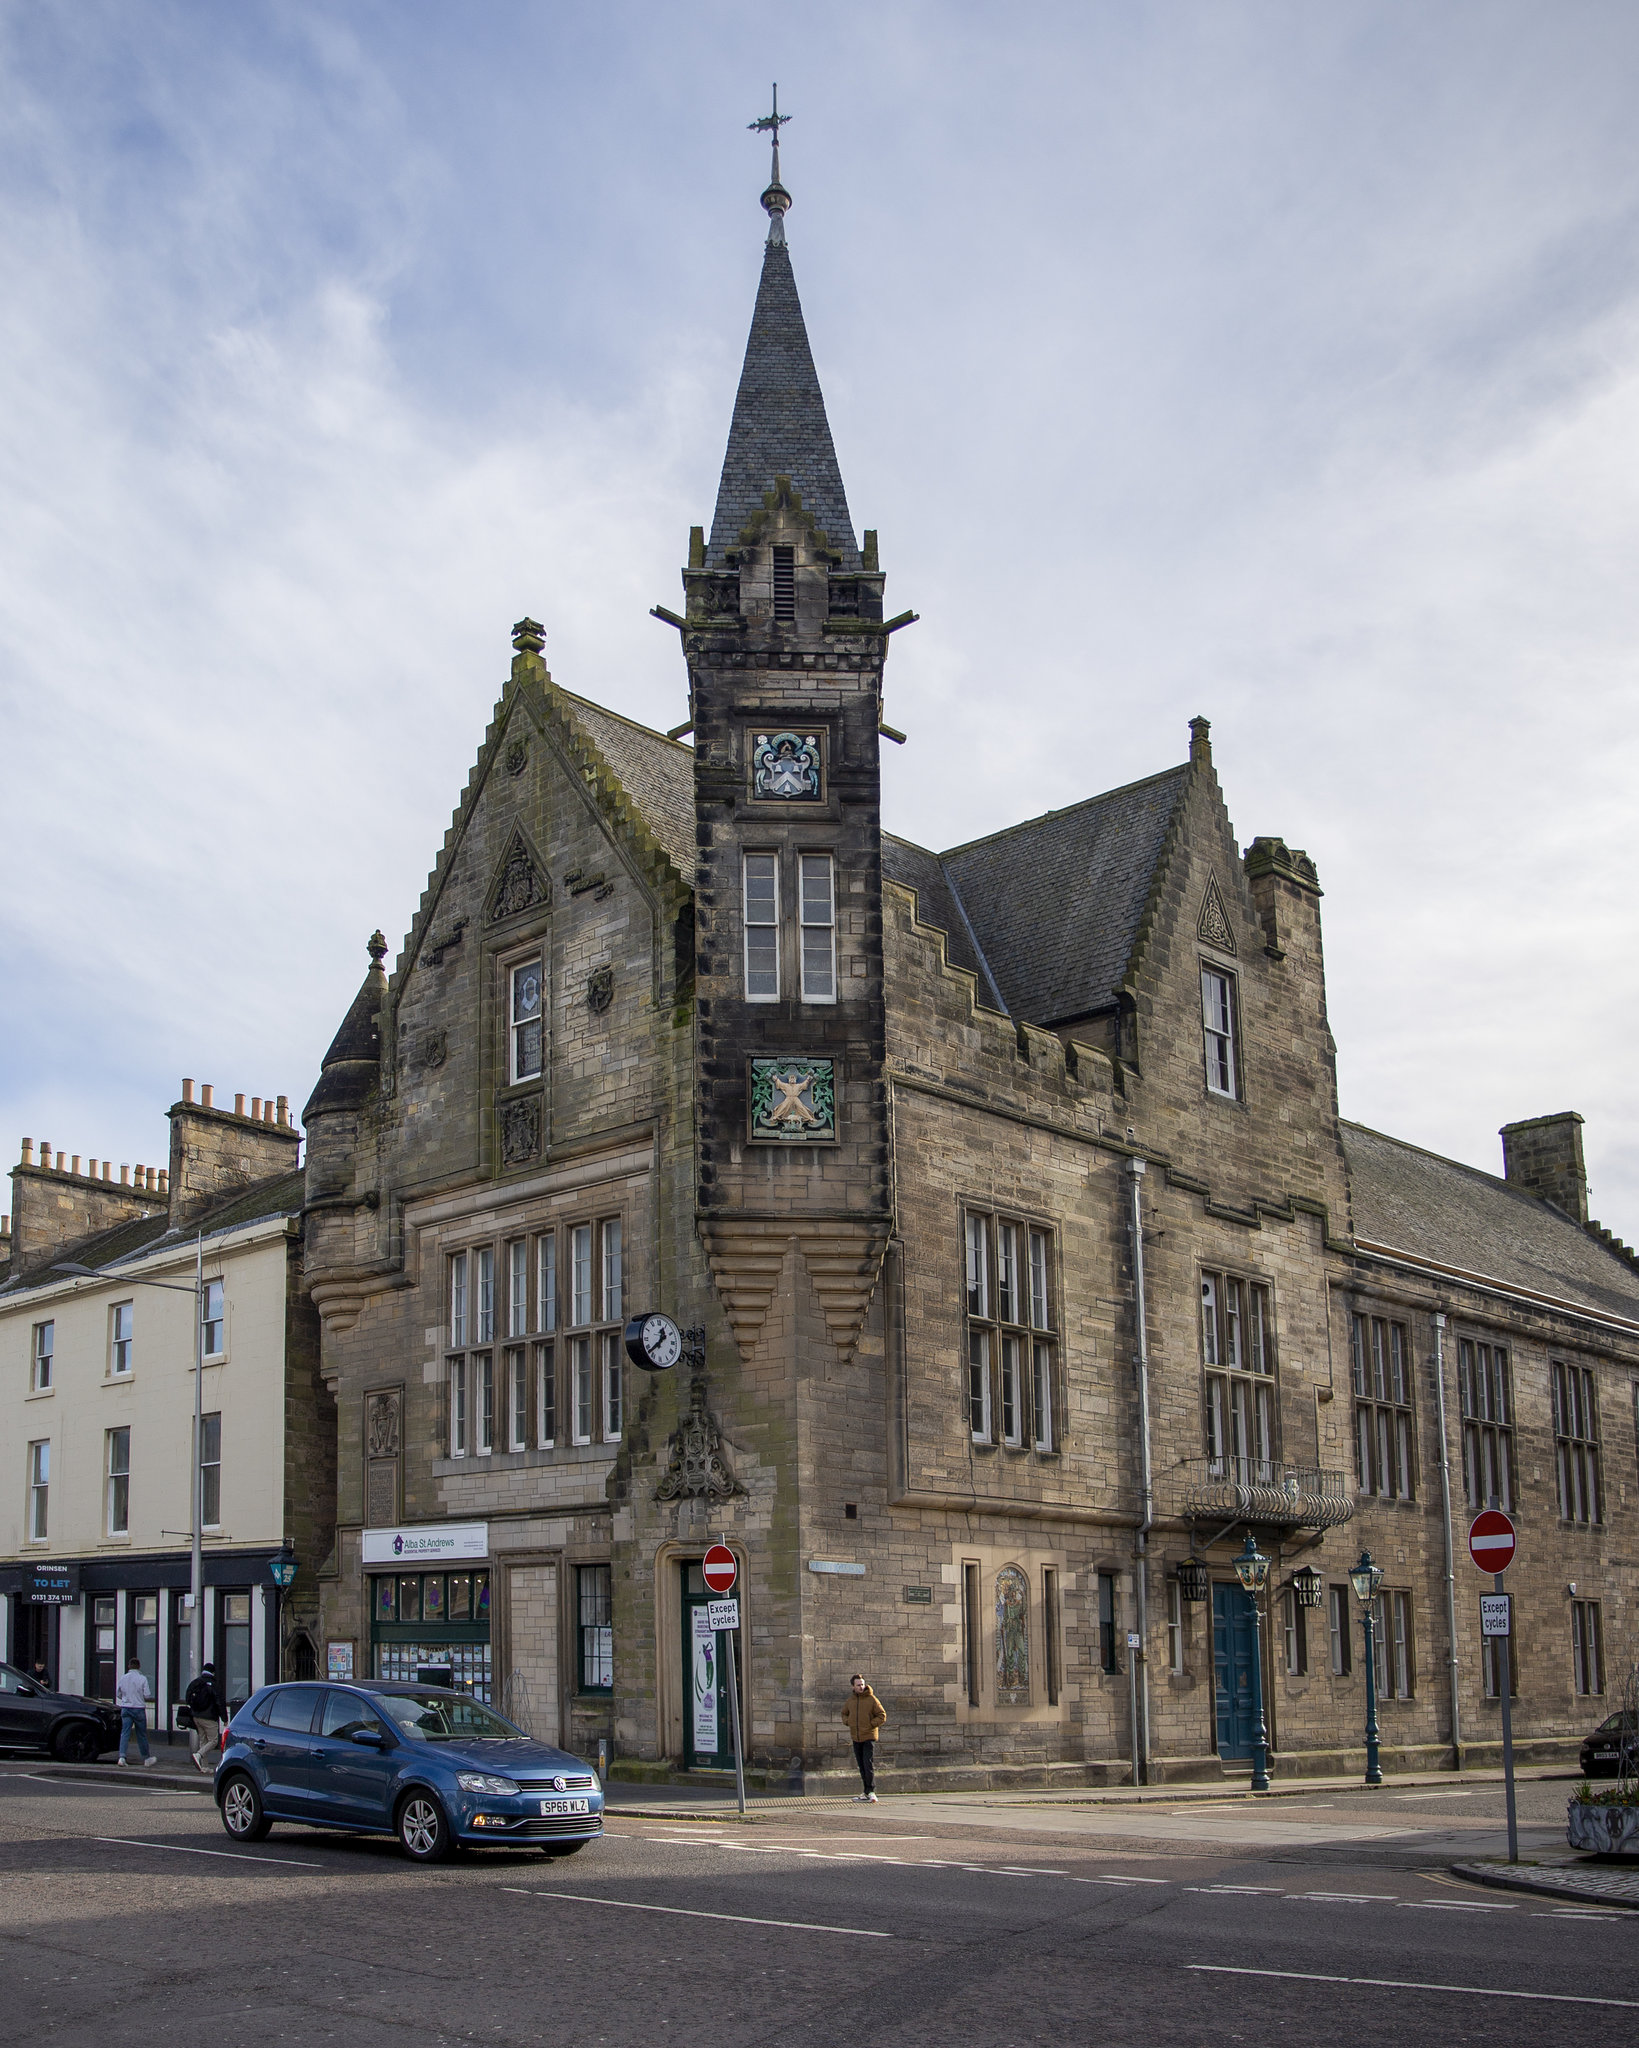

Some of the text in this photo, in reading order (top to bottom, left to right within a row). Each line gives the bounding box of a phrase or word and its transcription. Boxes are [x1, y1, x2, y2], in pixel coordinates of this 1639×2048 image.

[404, 1539, 418, 1549] Alba
[419, 1538, 426, 1548] St
[427, 1537, 455, 1548] Andrews
[34, 1579, 70, 1588] TO LET
[709, 1602, 736, 1615] Except
[1482, 1600, 1507, 1615] Except
[712, 1615, 736, 1627] cycles
[1485, 1616, 1507, 1630] cycles
[545, 1800, 586, 1813] SP66 WLZ
